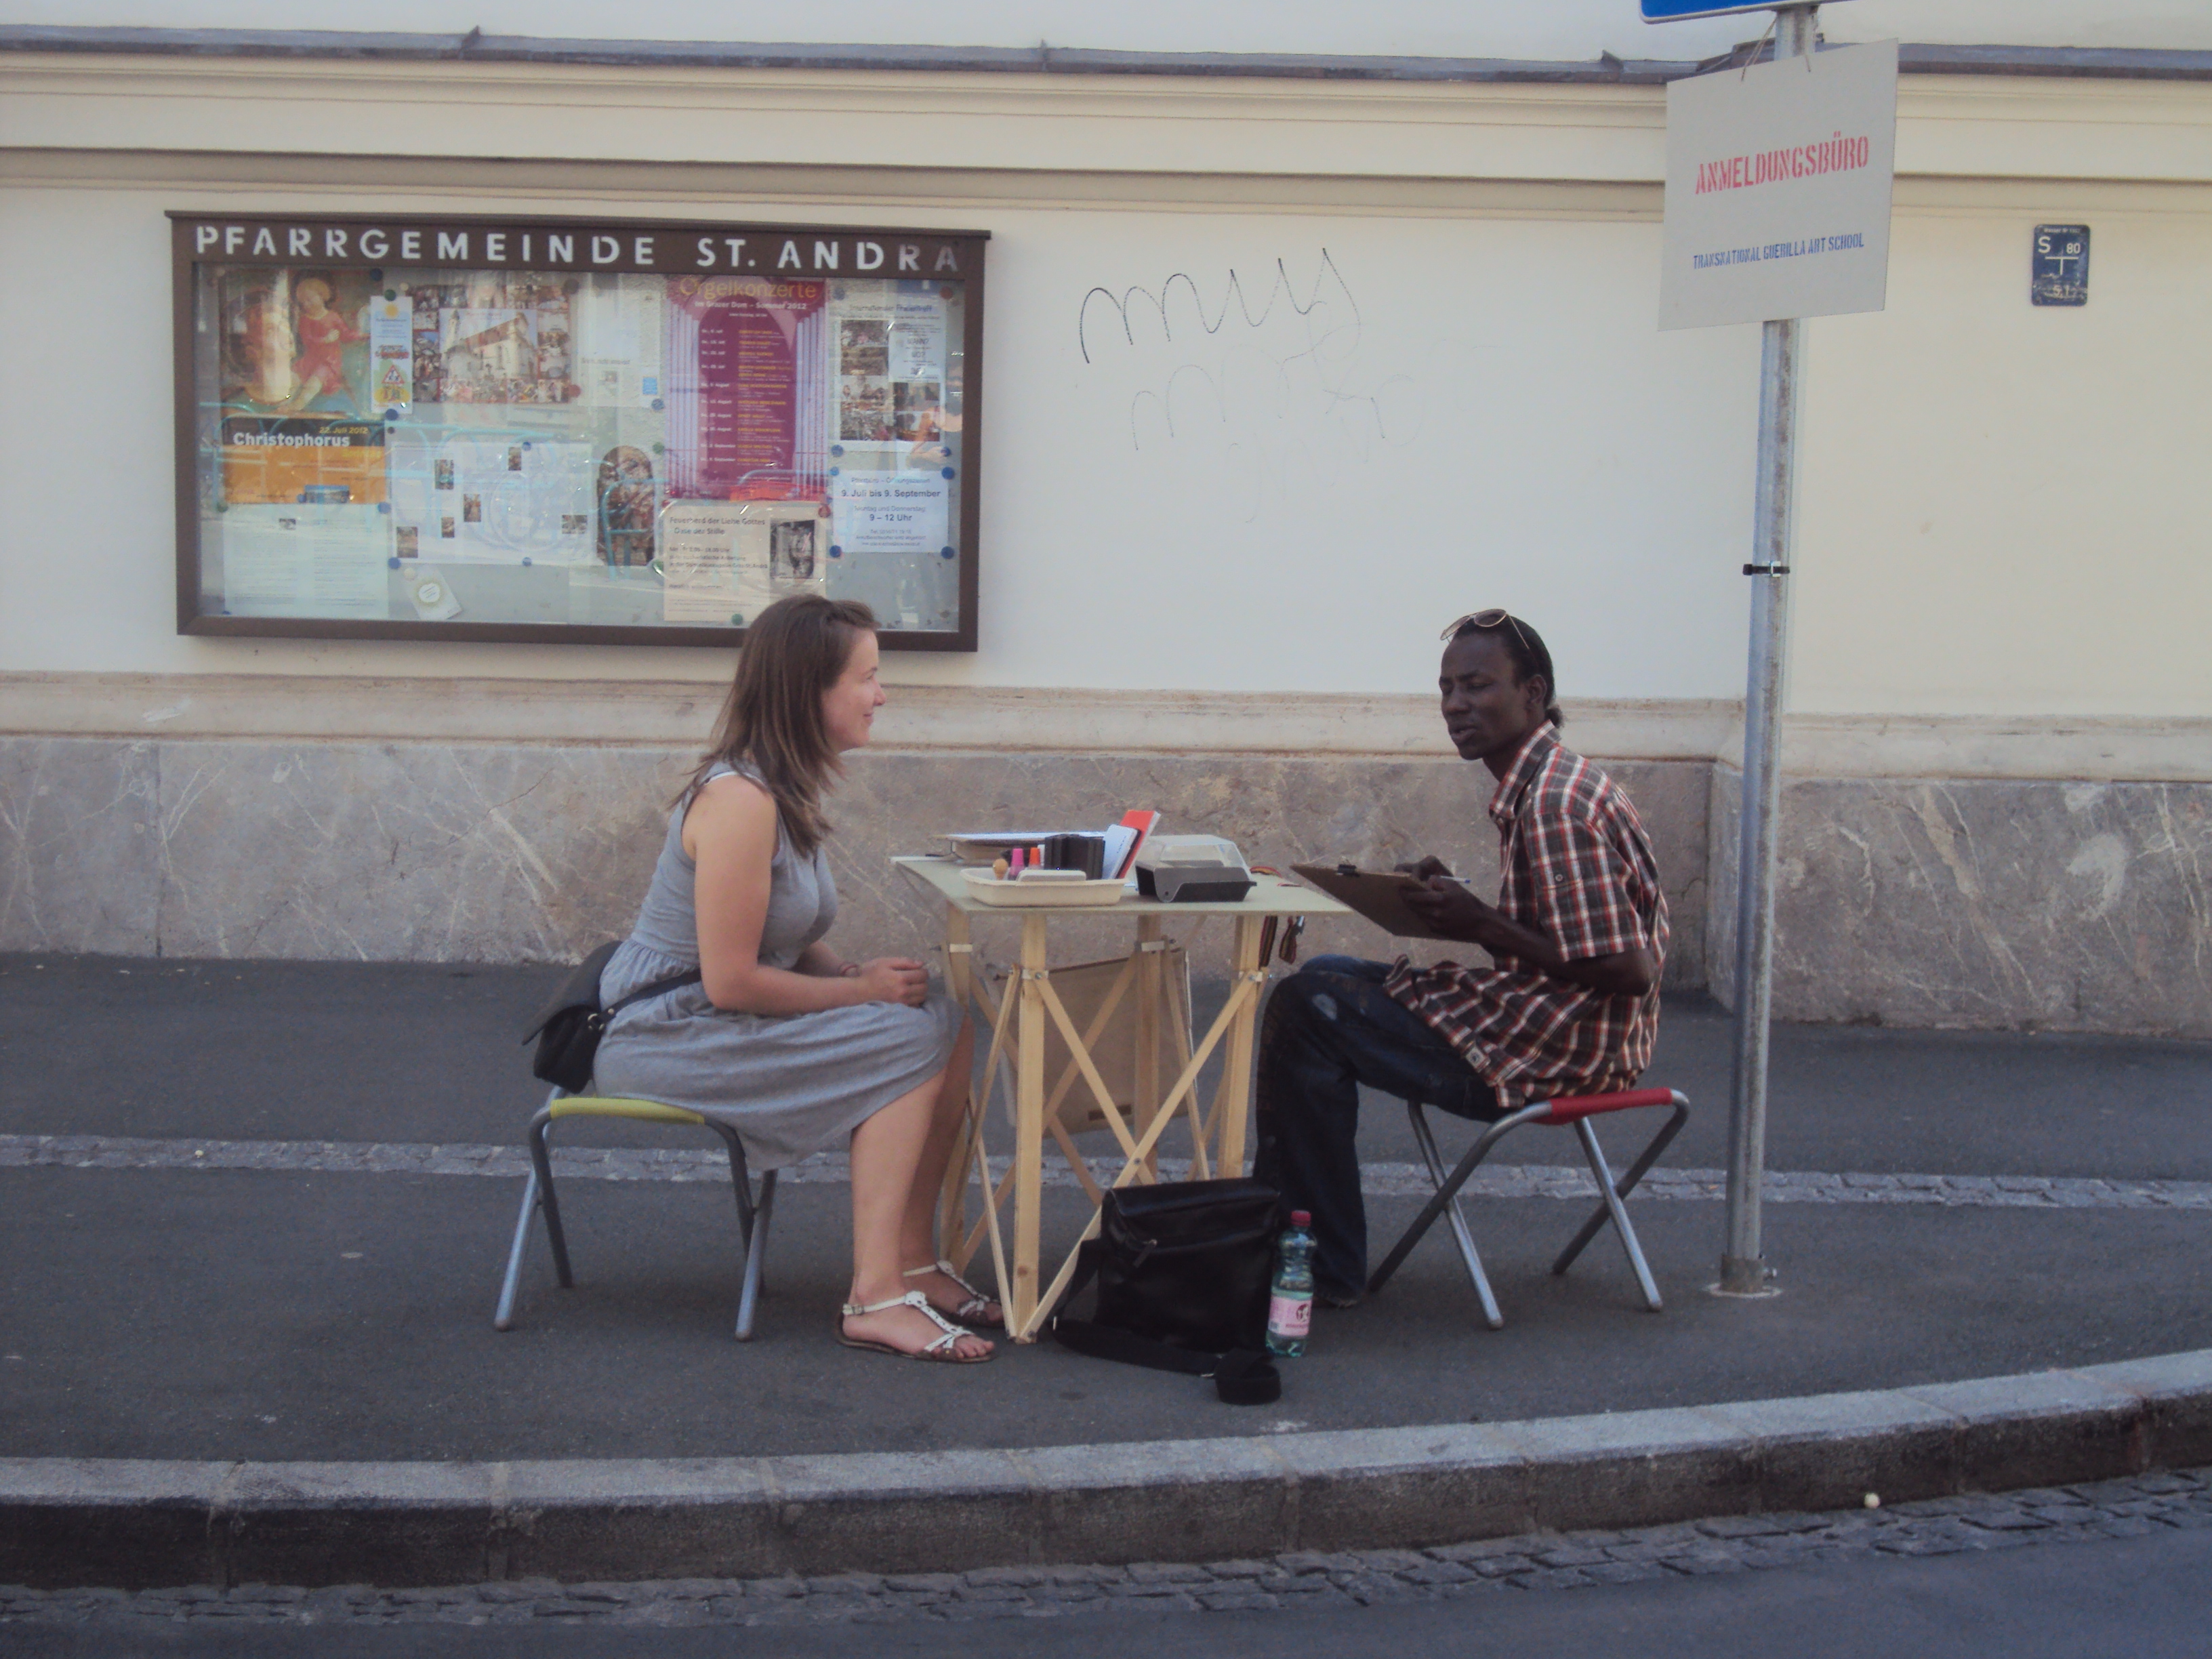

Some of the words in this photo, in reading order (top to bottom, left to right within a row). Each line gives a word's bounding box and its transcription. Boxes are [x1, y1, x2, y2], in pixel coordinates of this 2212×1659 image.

[1695, 130, 1869, 194] ANMELDUNGSBÜRO
[196, 226, 654, 265] PFARRGEMEINDE
[697, 238, 756, 267] ST.
[777, 241, 958, 272] ANDRA
[1693, 247, 1761, 270] TRANSNATIONAL
[1763, 240, 1805, 260] GUERILLA
[1808, 237, 1826, 254] ART
[1828, 232, 1864, 251] SCHOOL
[2038, 235, 2051, 253] S
[2066, 243, 2081, 254] 80
[680, 277, 817, 300] Orgelkonzerte
[232, 432, 350, 448] Christophorus
[895, 489, 941, 499] September
